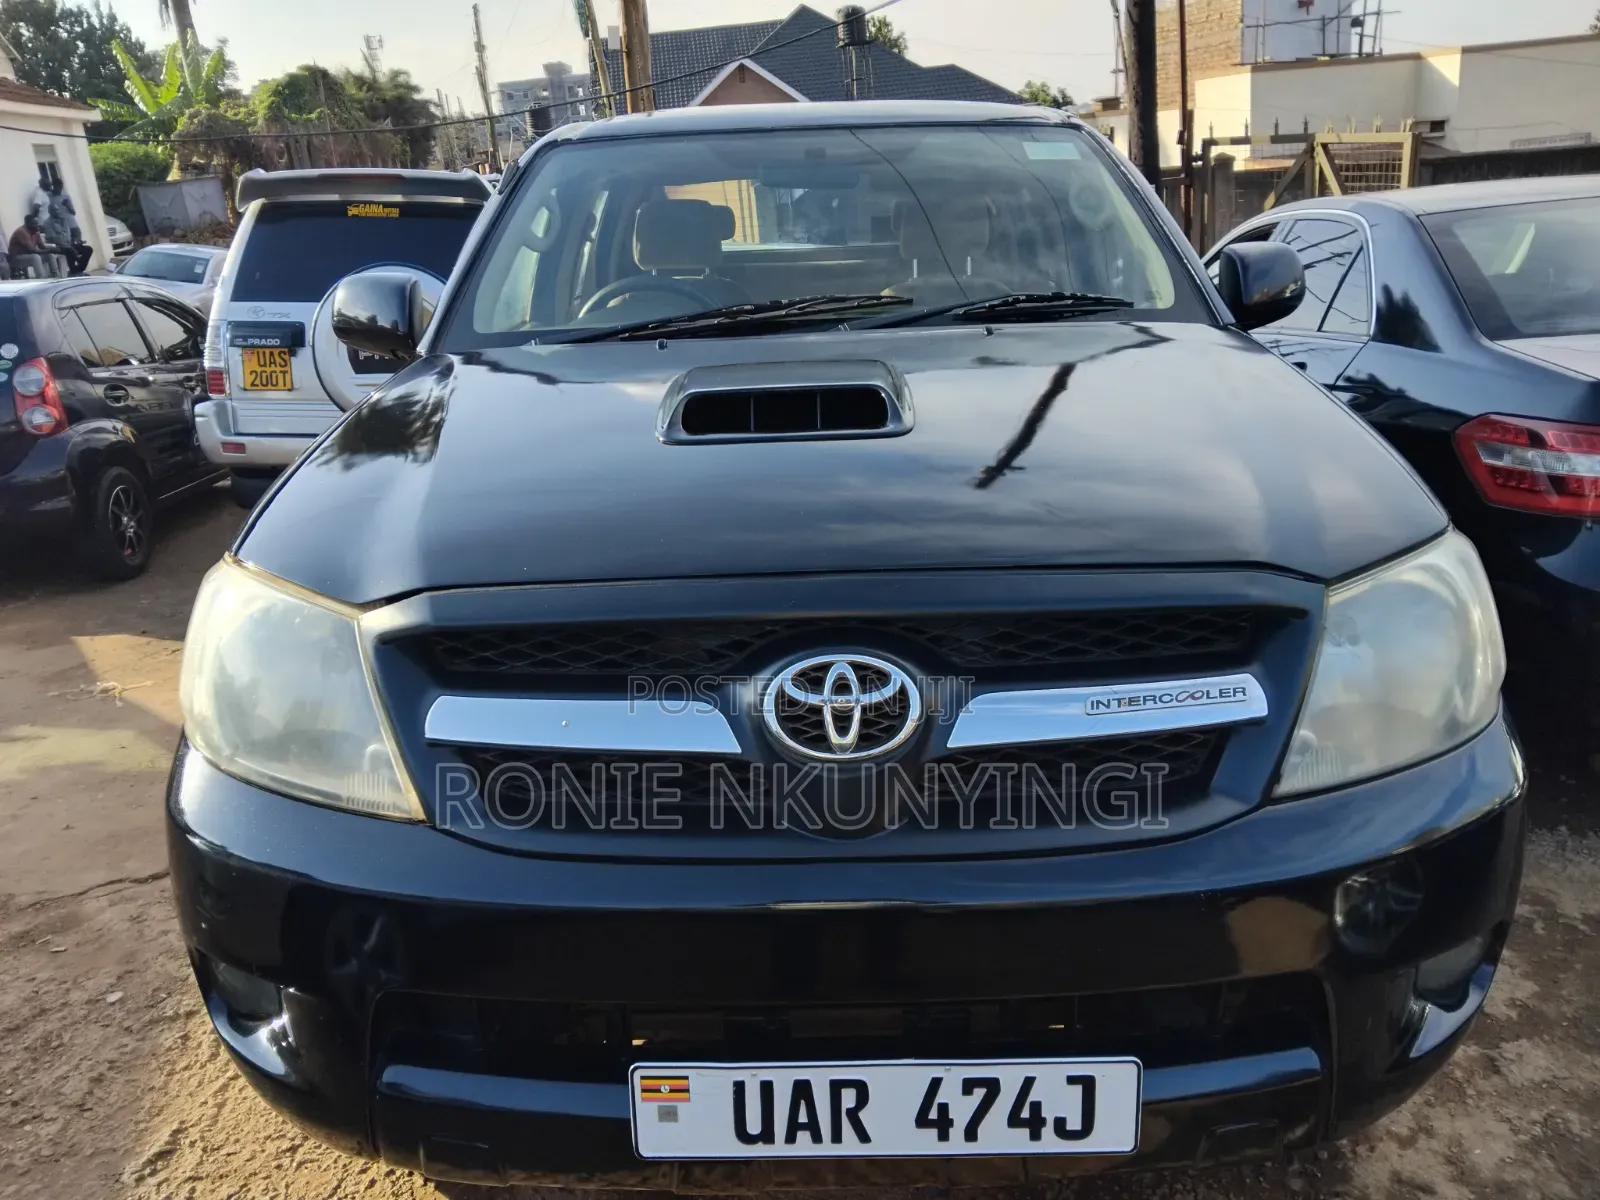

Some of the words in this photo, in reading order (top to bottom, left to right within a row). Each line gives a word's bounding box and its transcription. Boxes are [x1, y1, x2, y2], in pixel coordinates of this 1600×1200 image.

[360, 203, 383, 213] GAINA
[247, 338, 280, 346] PRADO
[257, 350, 288, 368] UAS
[249, 370, 288, 387] 200T
[1090, 686, 1247, 711] INTERCOOLER
[732, 1078, 872, 1146] UAR
[914, 1074, 1097, 1143] 474J
